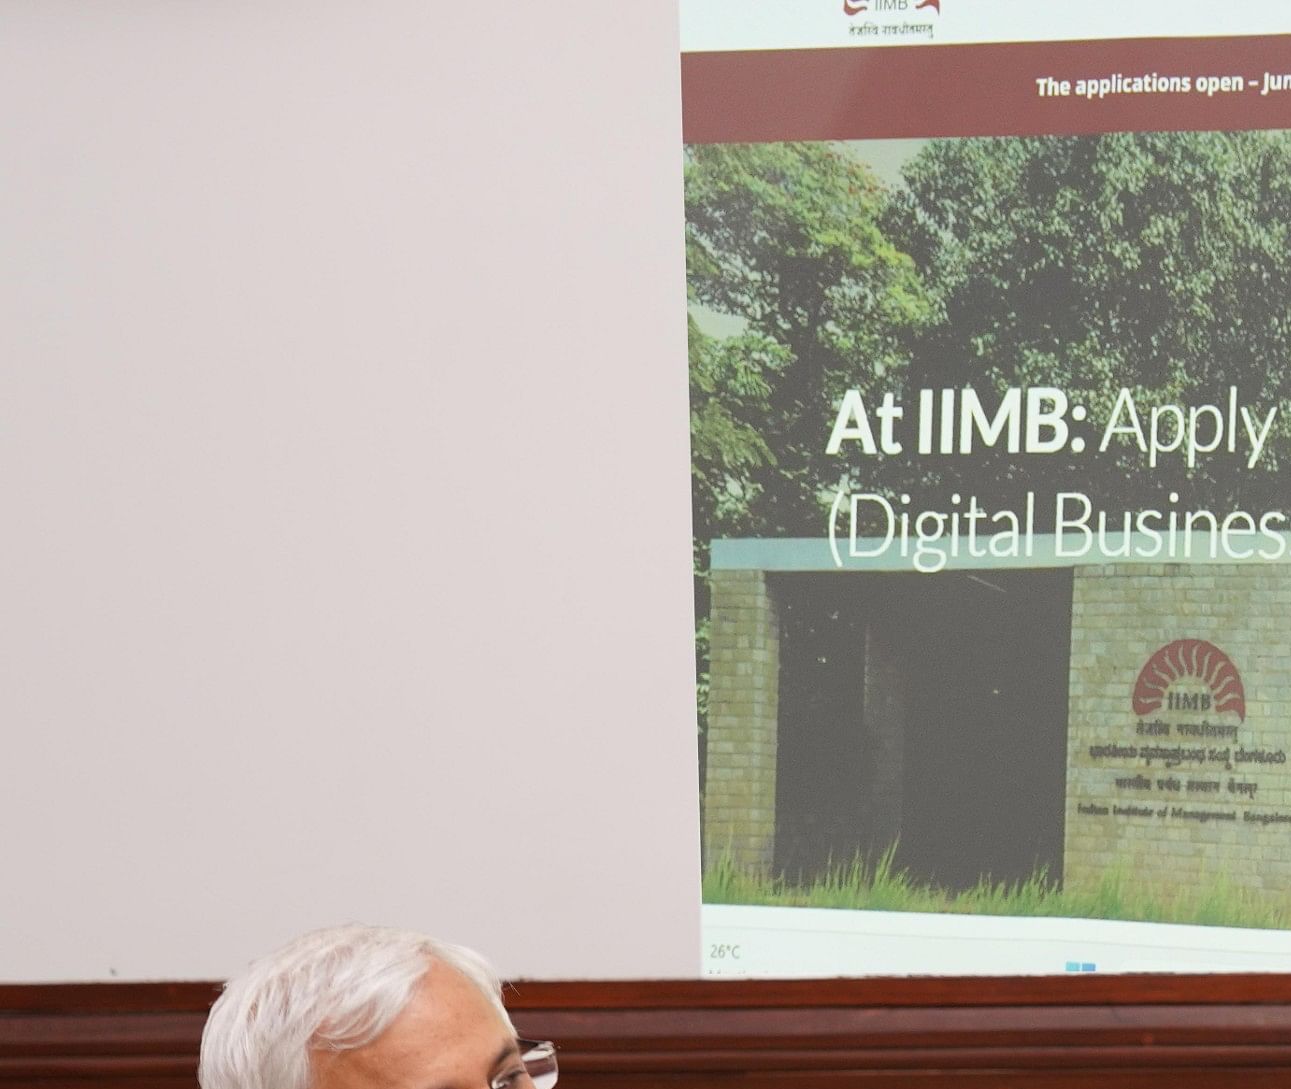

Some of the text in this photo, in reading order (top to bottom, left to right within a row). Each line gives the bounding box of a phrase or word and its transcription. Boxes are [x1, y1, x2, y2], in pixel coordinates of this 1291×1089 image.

[1036, 77, 1070, 97] The
[1075, 73, 1191, 98] applications
[1195, 75, 1244, 96] open
[825, 389, 903, 455] At
[918, 387, 1086, 455] IIMB:
[1099, 385, 1278, 469] Apply
[828, 490, 1035, 573] (Digital
[1168, 692, 1212, 711] IIMB
[1077, 803, 1109, 816] Indian
[1113, 803, 1154, 818] Institute
[1157, 804, 1168, 818] of
[1171, 807, 1236, 823] Management
[710, 944, 741, 960] 26°C
